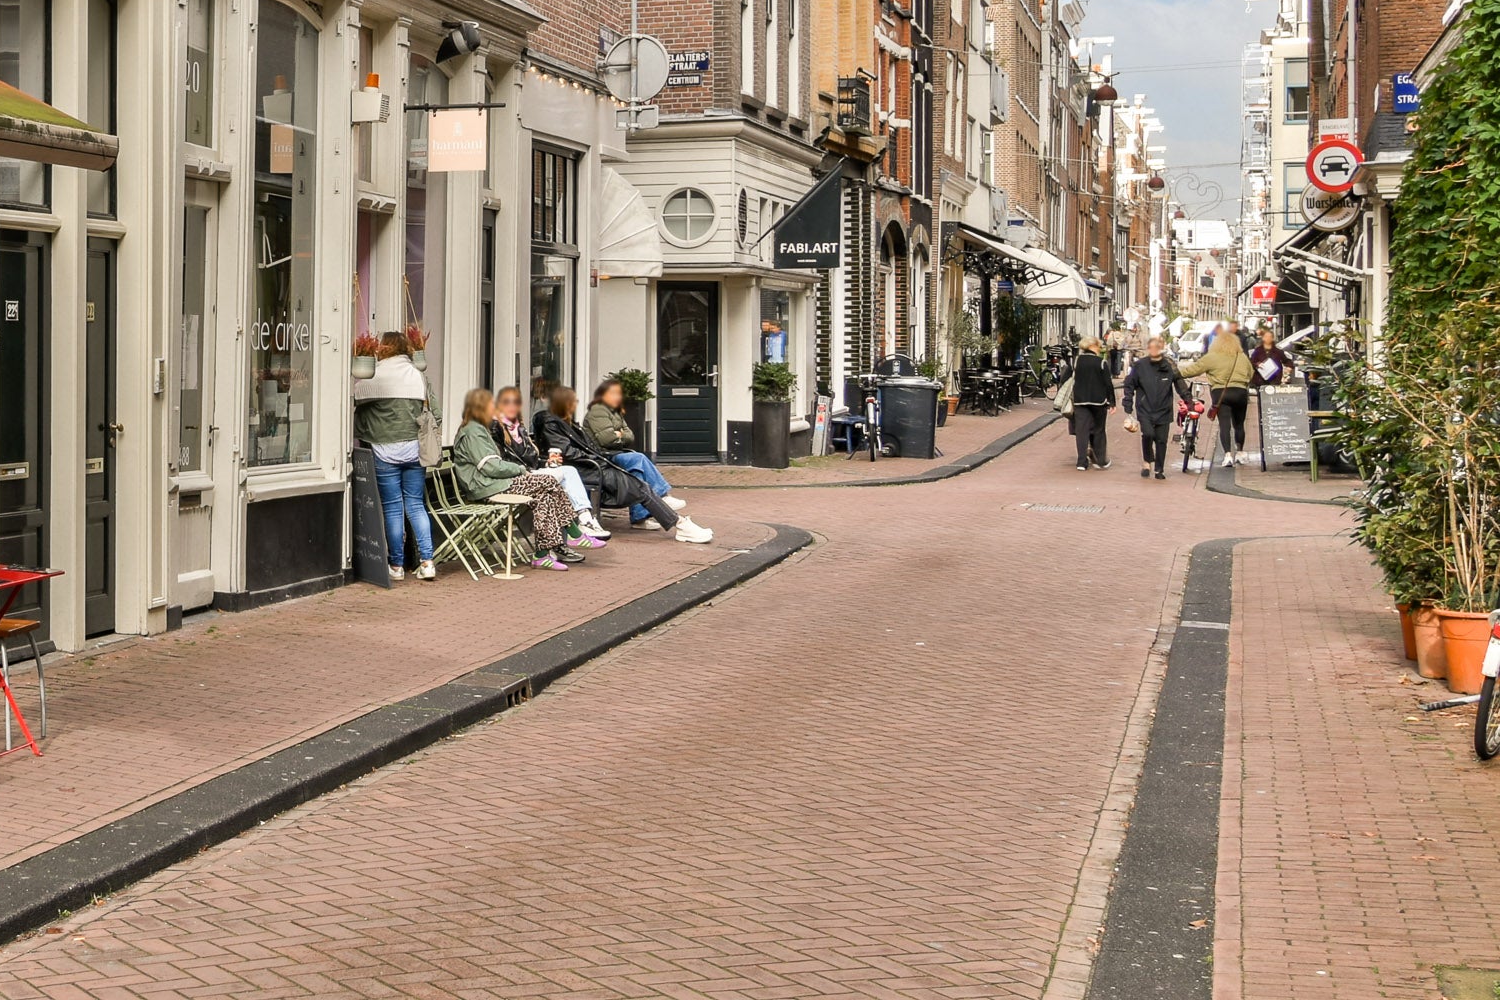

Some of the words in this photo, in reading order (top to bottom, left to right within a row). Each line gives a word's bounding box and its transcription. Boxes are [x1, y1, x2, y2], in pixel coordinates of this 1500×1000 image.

[668, 76, 700, 85] CENTRUM
[780, 242, 839, 254] FABI.ART
[251, 307, 270, 351] de
[275, 309, 312, 352] cirkel
